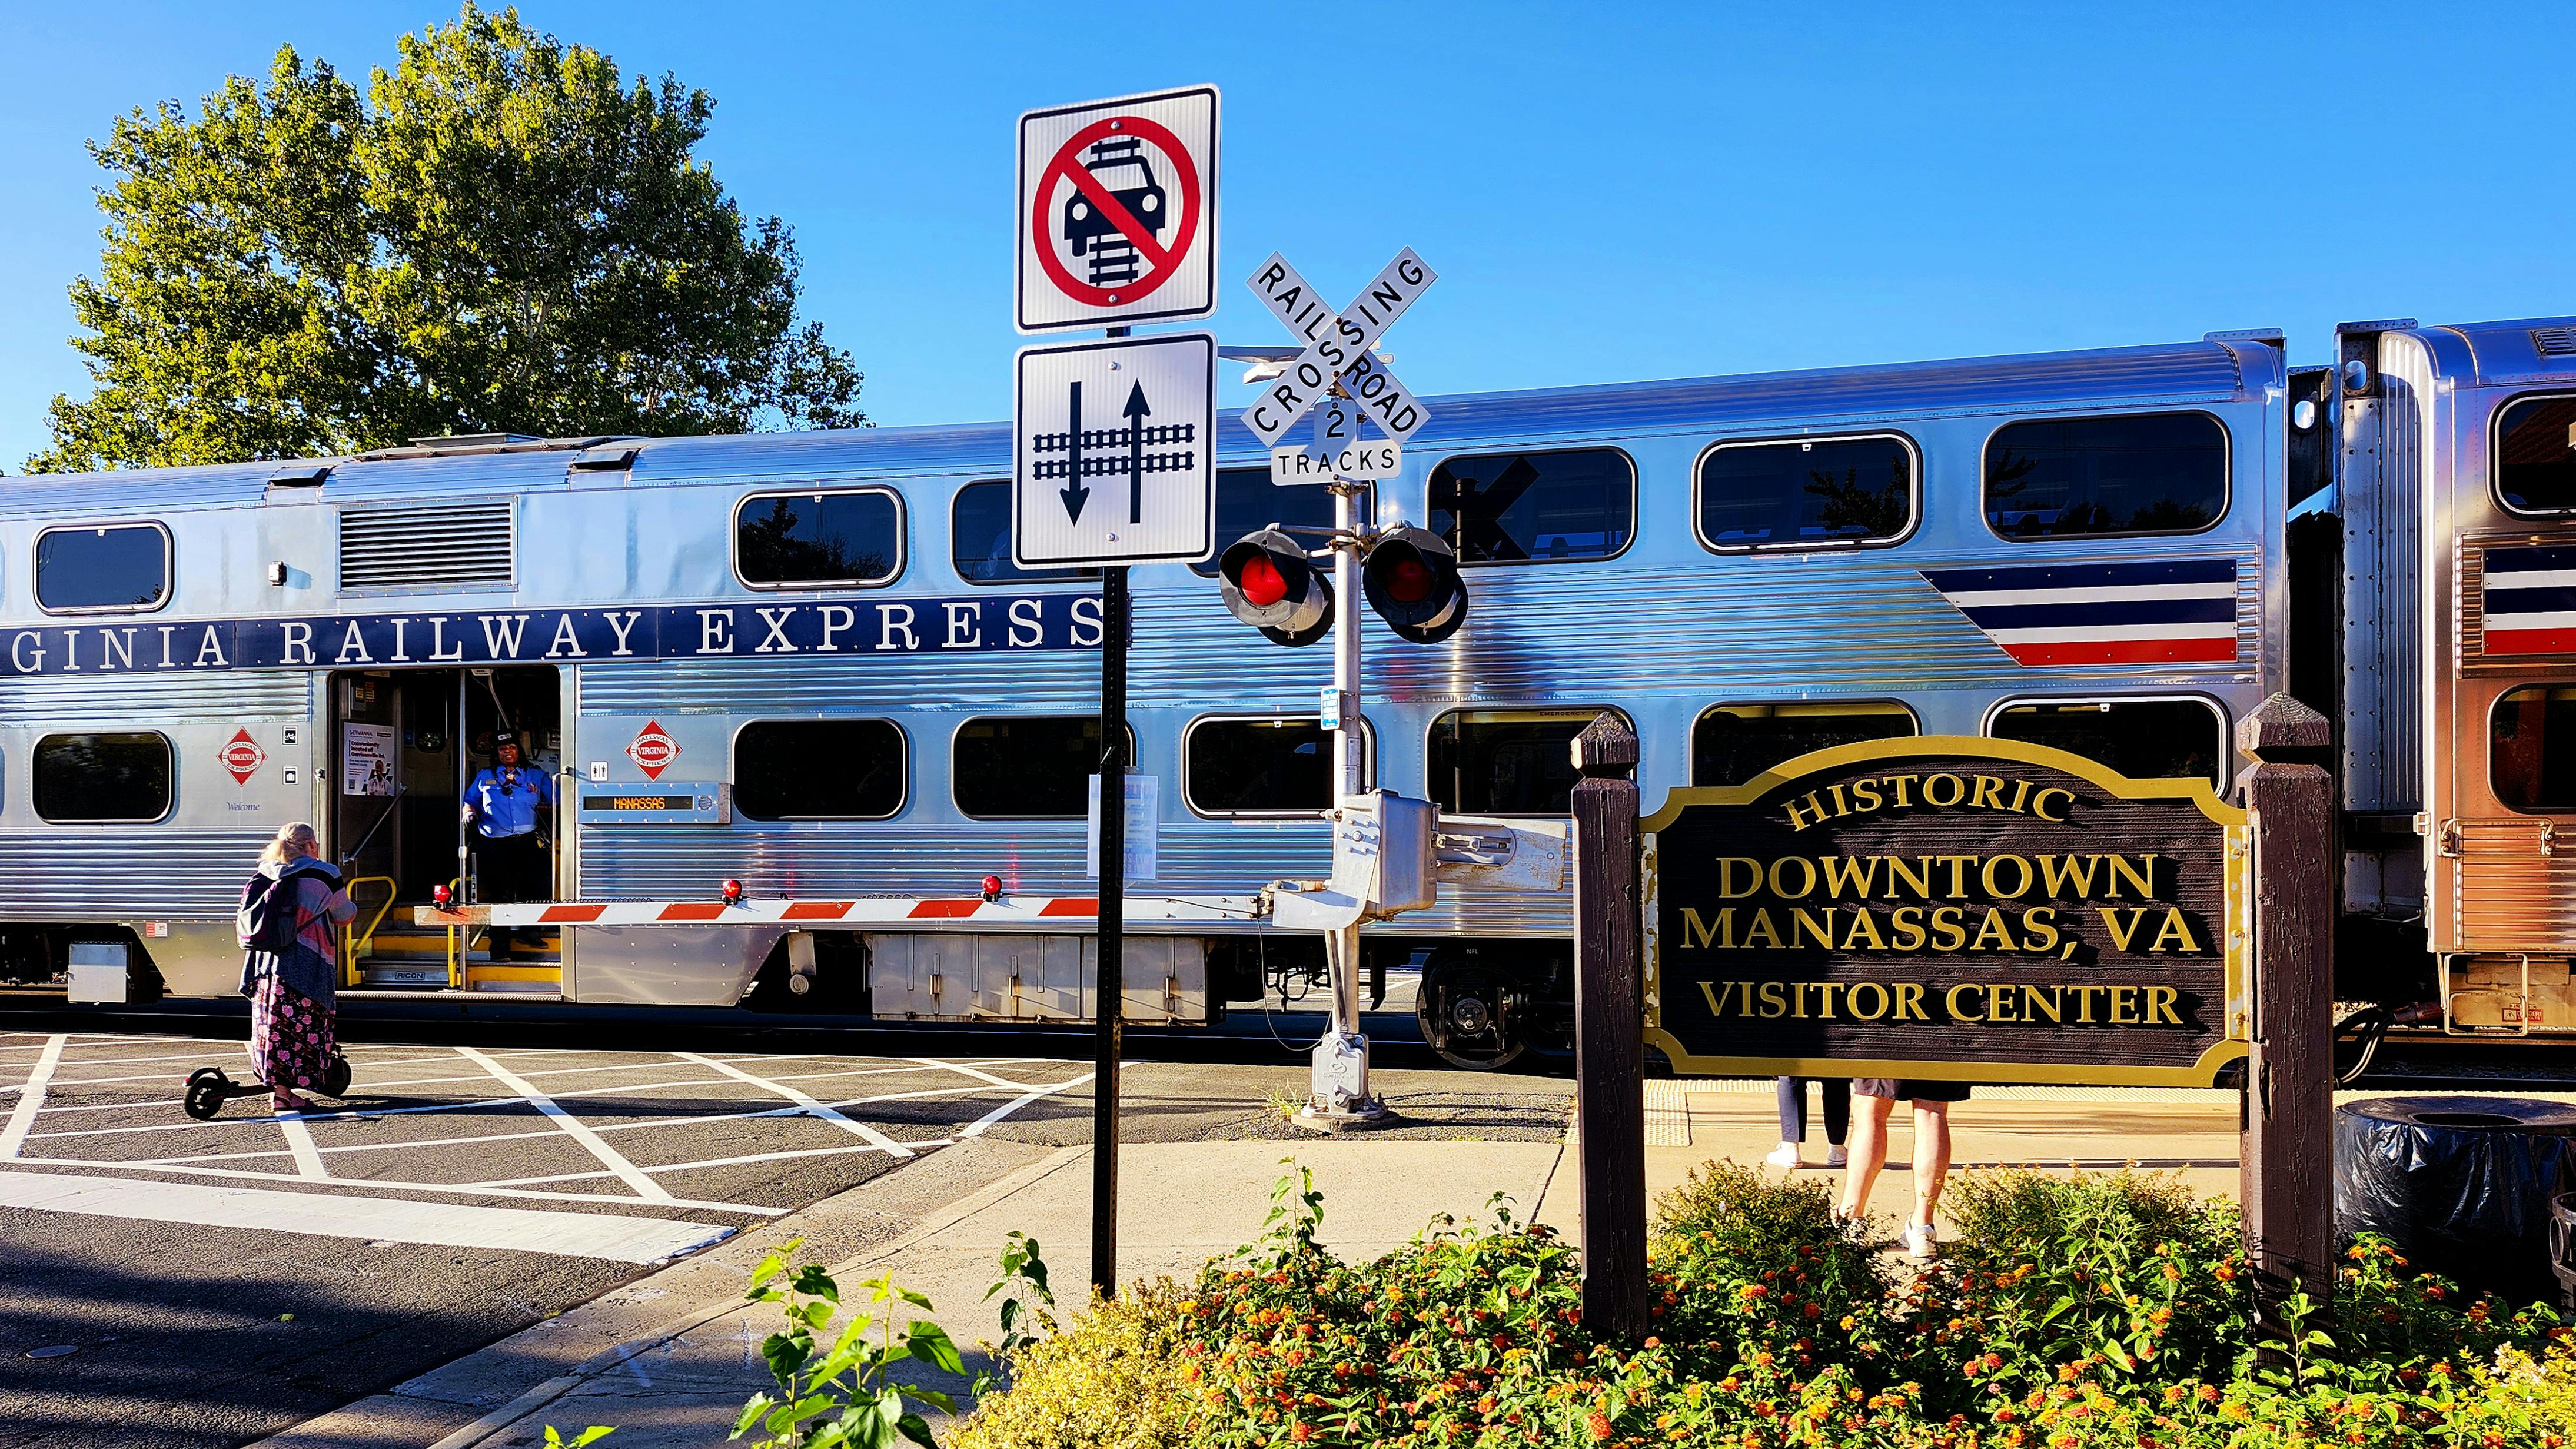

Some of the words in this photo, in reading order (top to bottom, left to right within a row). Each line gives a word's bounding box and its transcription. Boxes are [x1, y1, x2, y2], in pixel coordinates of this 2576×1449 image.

[1254, 259, 1424, 433] CROSSING
[1325, 410, 1345, 438] 2
[1278, 448, 1394, 474] TRACKS
[12, 624, 229, 673] GINIA
[279, 611, 641, 665] RAILWAY
[696, 597, 1103, 654] EXPRESS
[227, 742, 258, 751] RAILWAY
[636, 735, 670, 745] RAILWAY
[637, 746, 669, 755] VIRGINIA
[227, 763, 258, 772] EXPRESS
[636, 756, 670, 766] EXPRESS
[227, 802, 260, 811] Welcome
[614, 797, 666, 810] MANASSAS
[1781, 773, 2077, 832] HISTORIC
[1716, 853, 2159, 900] DOWNTOWN
[1679, 906, 2076, 961] MANASSAS,
[2095, 906, 2202, 952] VA
[1696, 981, 1932, 1022] VISITOR
[1946, 983, 2184, 1024] CENTER
